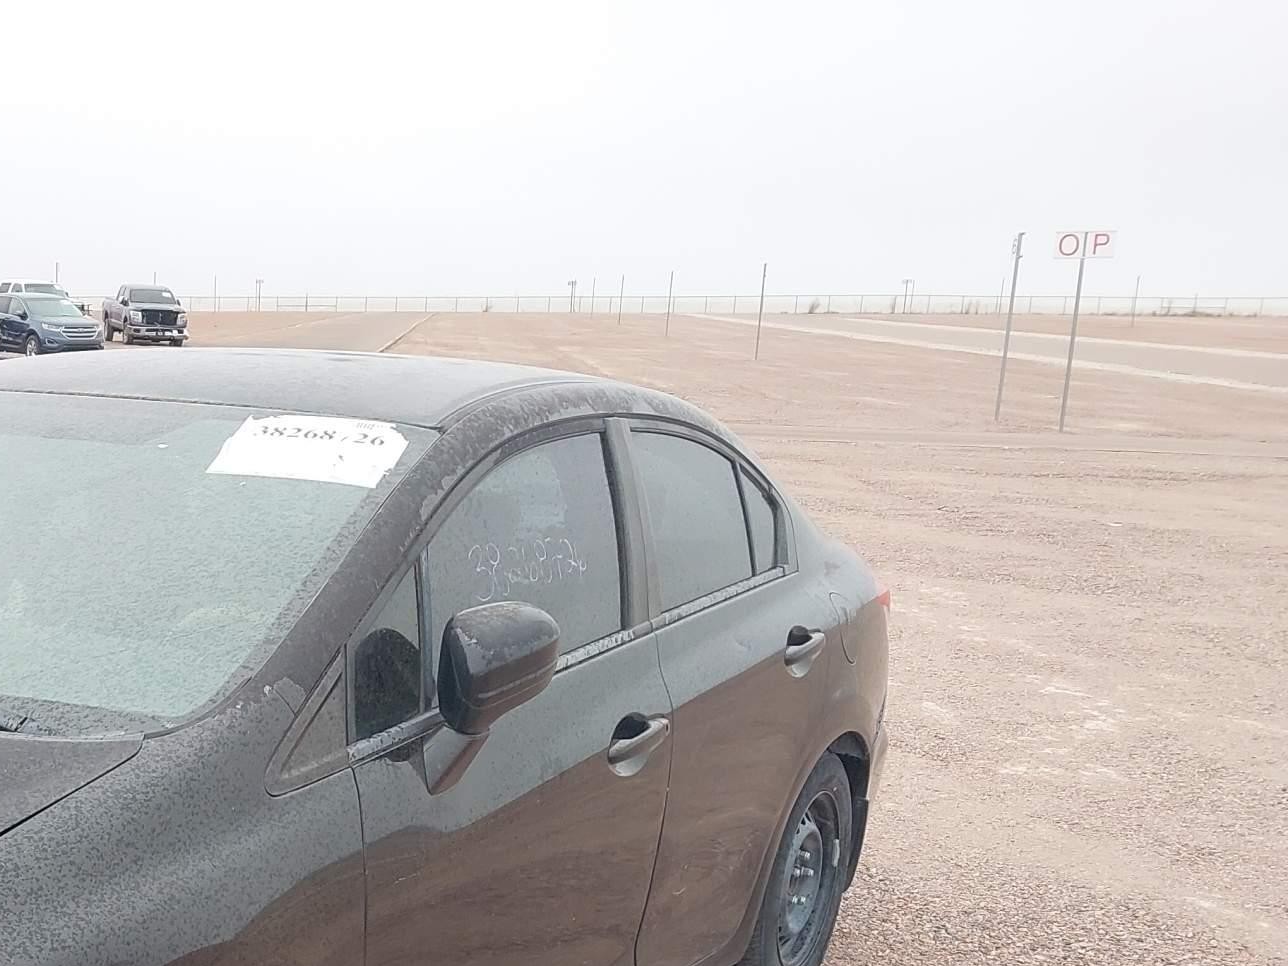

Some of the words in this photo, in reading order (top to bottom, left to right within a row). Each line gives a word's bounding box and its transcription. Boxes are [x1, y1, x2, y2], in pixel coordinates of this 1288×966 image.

[1058, 233, 1080, 256] O
[1092, 233, 1110, 255] P
[252, 424, 385, 446] 3826826
